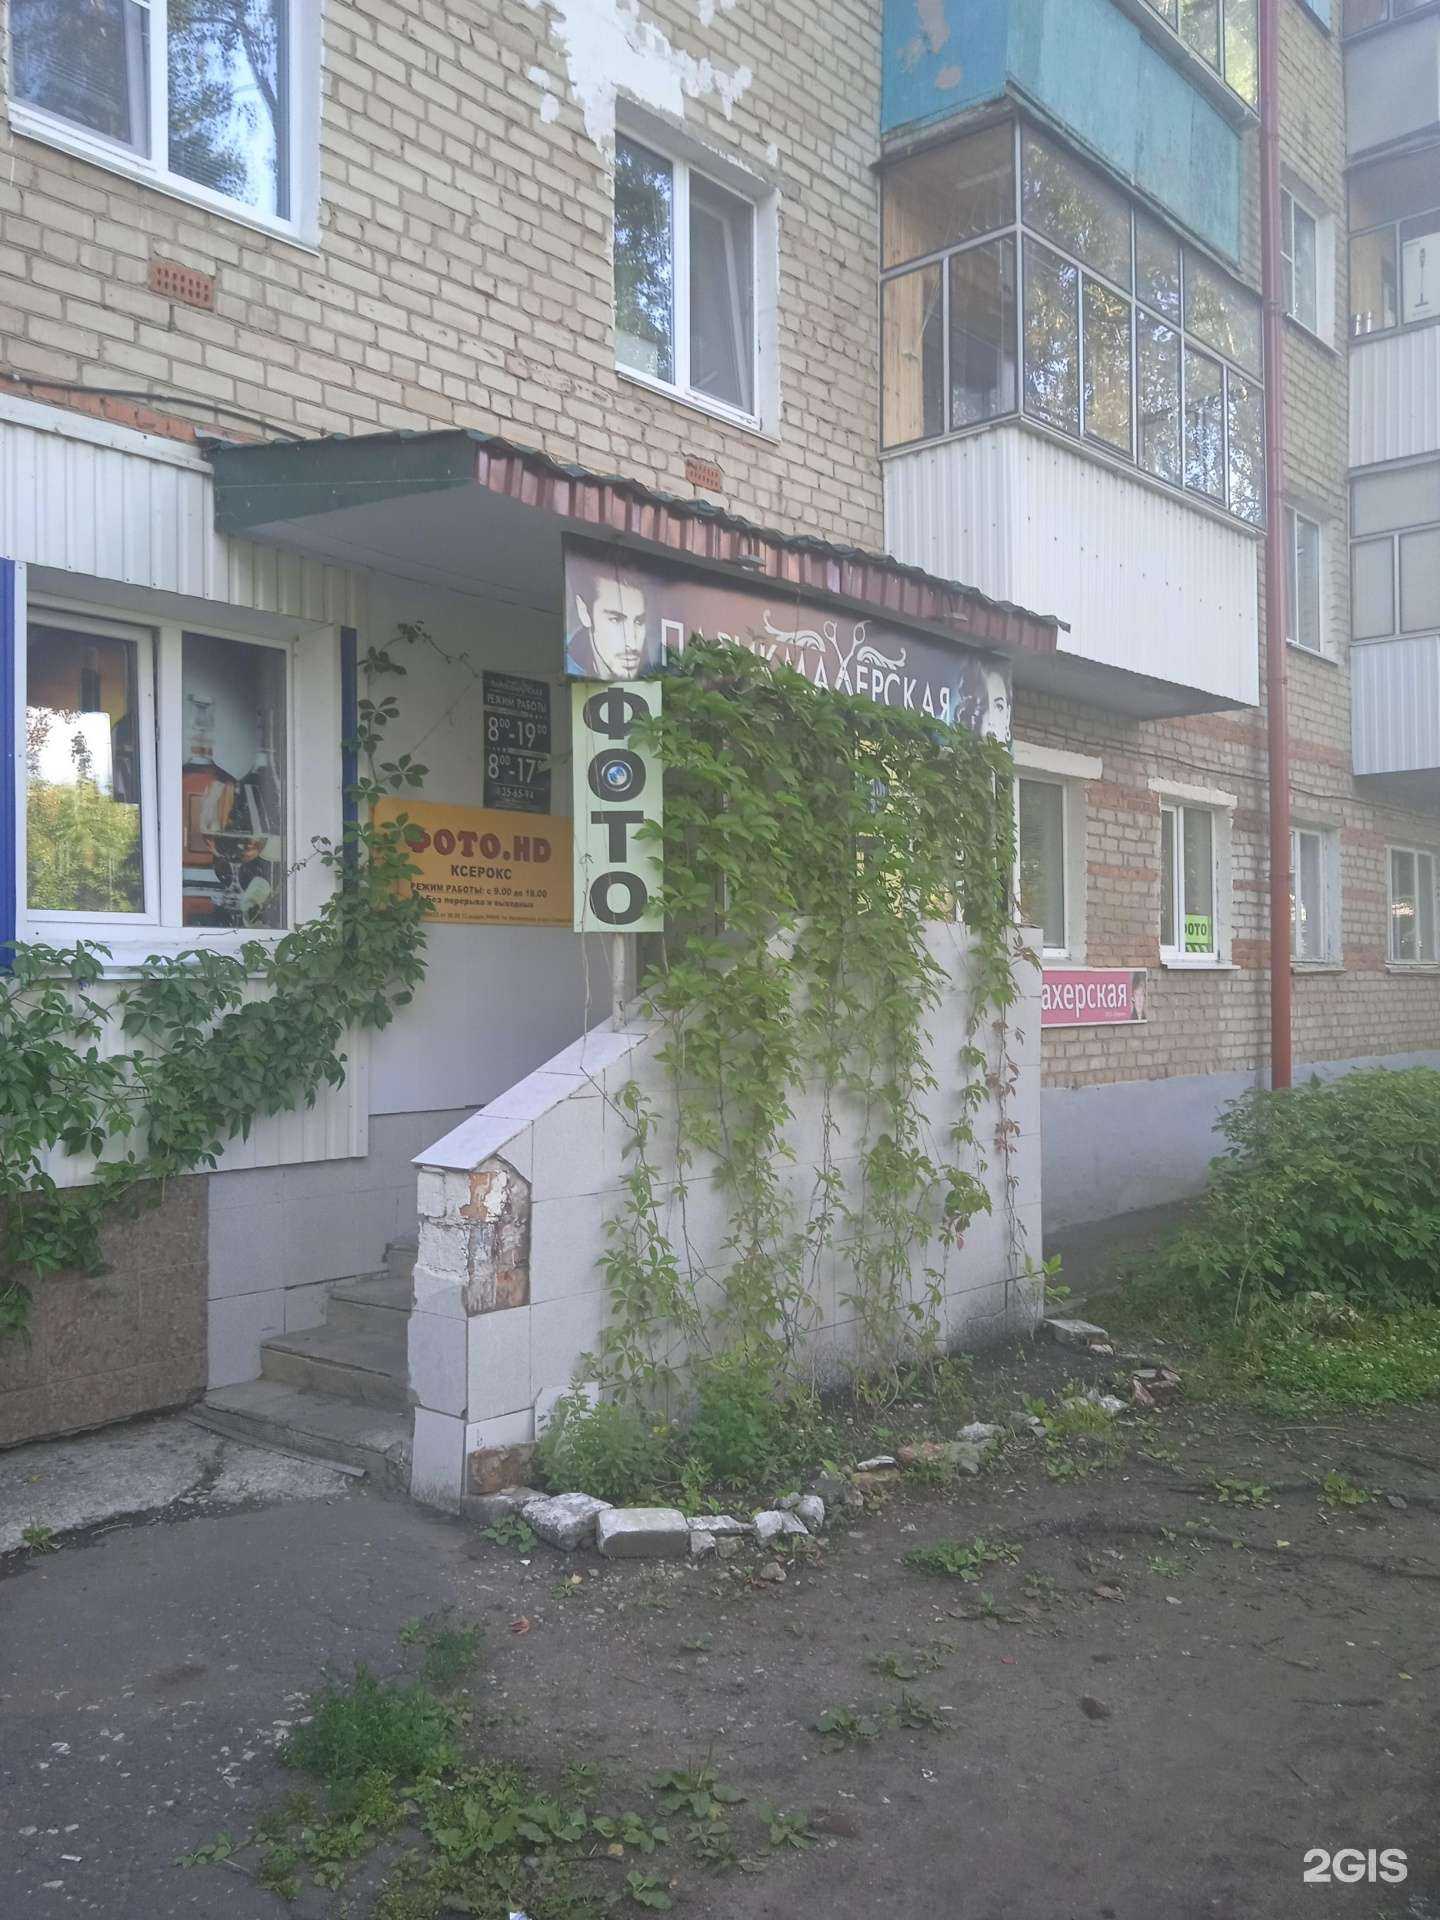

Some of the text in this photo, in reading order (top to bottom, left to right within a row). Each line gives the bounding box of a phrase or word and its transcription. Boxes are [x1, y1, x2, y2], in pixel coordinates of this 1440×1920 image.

[661, 618, 950, 726] ПАХЕРСКАЯ
[582, 687, 649, 925] ФОТО
[411, 882, 444, 893] РЕЖИМ
[451, 864, 513, 881] КСЕРОКС
